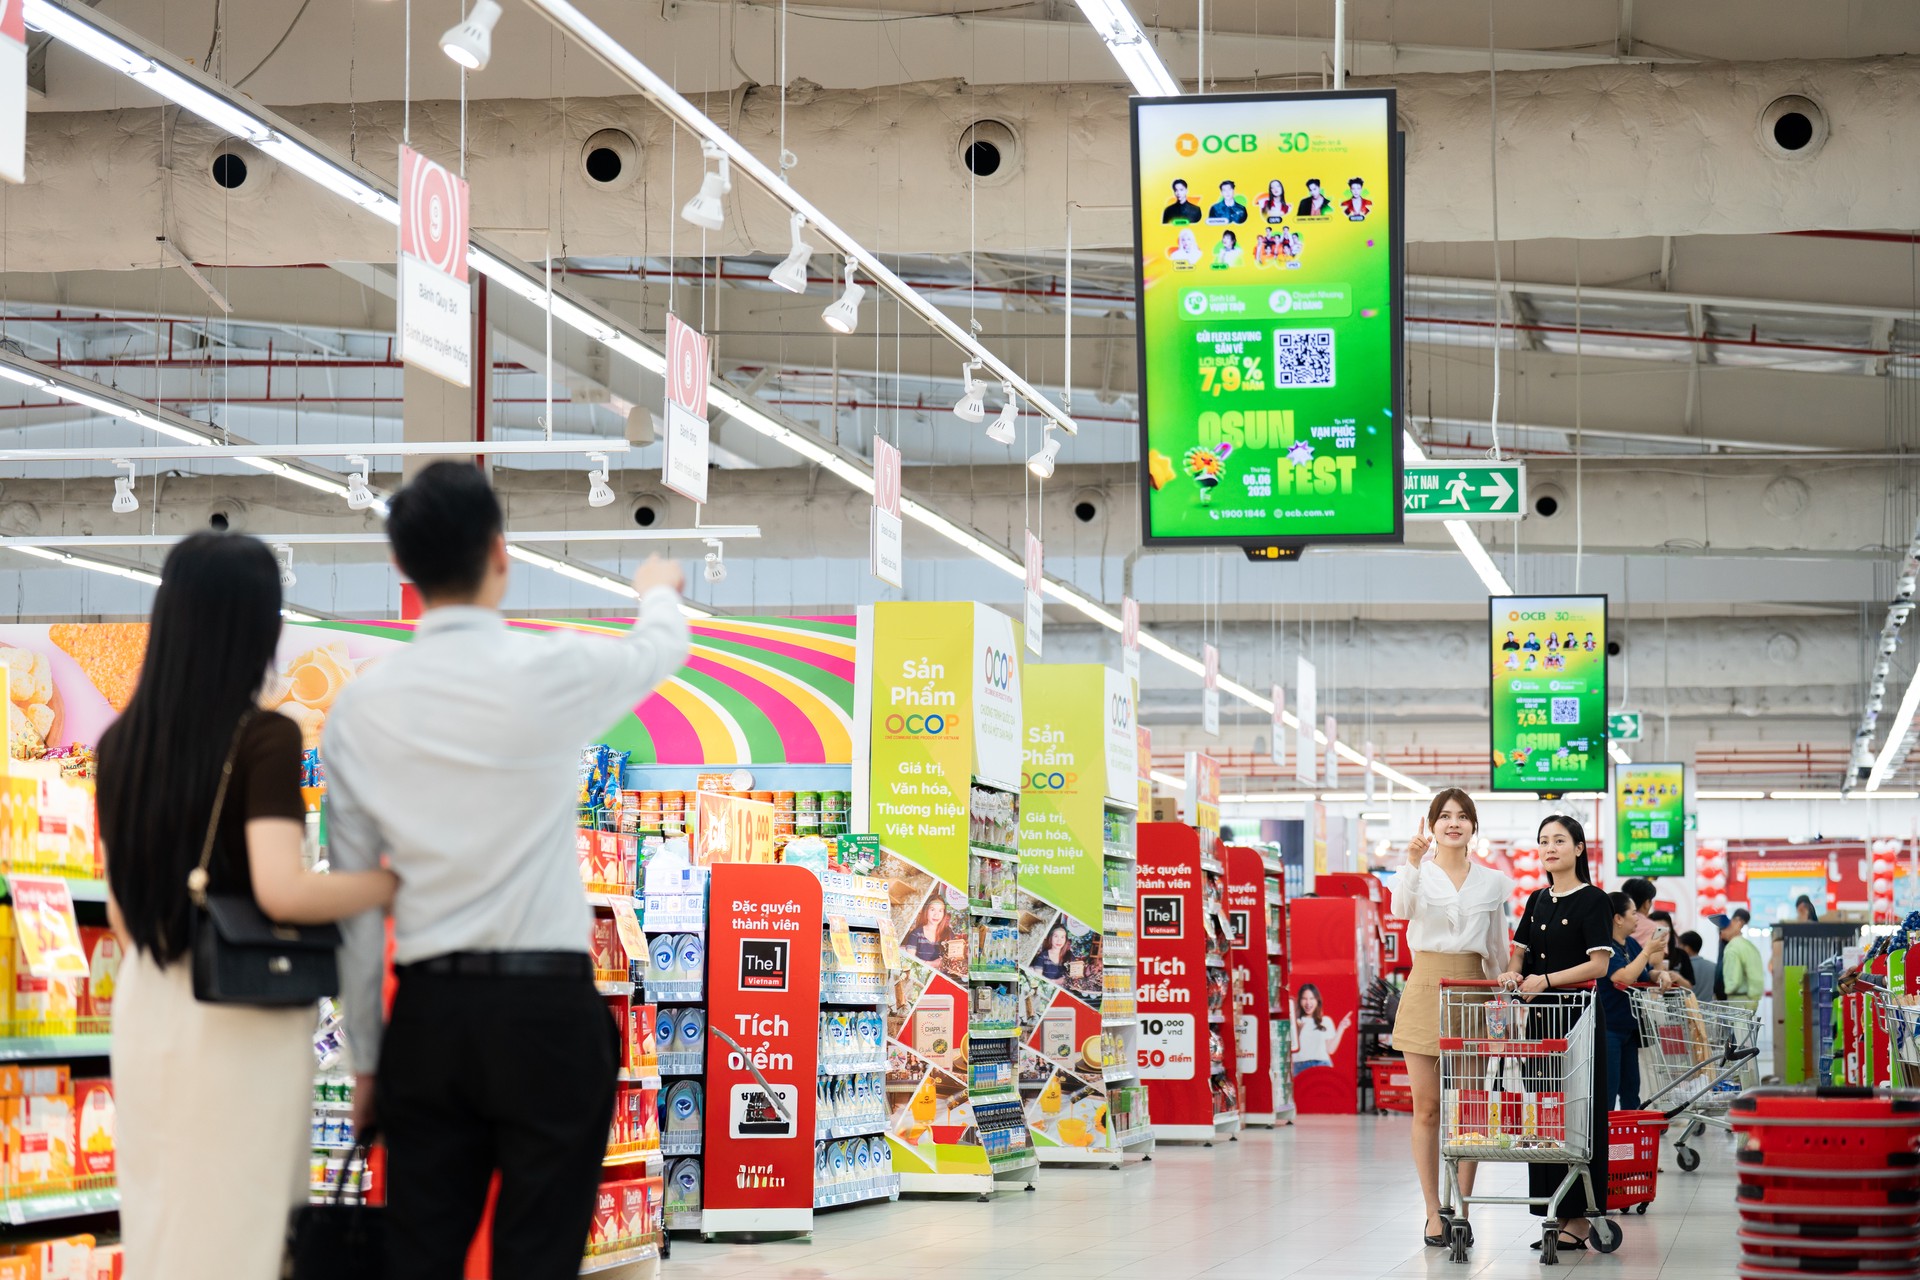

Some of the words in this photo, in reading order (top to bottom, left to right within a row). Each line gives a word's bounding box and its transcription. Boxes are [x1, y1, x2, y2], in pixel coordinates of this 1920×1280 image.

[1202, 133, 1258, 154] OCB
[1276, 131, 1310, 153] 30
[1231, 331, 1262, 342] SAVING
[1198, 365, 1241, 397] 7,9
[1197, 409, 1295, 450] OSUN
[1335, 437, 1356, 449] CITY
[1277, 455, 1357, 495] FEST
[1403, 472, 1418, 490] OÁT
[1403, 494, 1429, 509] XIT
[1221, 510, 1243, 519] 1900
[1243, 509, 1266, 518] 1846
[1284, 508, 1335, 518] ocb.com.vn
[1520, 611, 1546, 621] OCB
[902, 656, 945, 679] Sản
[985, 646, 1014, 692] OCOP
[891, 681, 955, 706] Phẩm
[885, 713, 960, 735] OCOP
[1028, 724, 1065, 744] Sản
[1516, 732, 1561, 751] OSUN
[1020, 743, 1075, 766] Phẩm
[1551, 753, 1589, 772] FEST
[898, 762, 922, 775] Giá
[925, 762, 945, 777] trị,
[891, 782, 917, 795] Văn
[921, 782, 951, 797] hóa,
[877, 802, 934, 818] Thương
[935, 802, 965, 818] hiệu
[1025, 812, 1047, 823] Giá
[1048, 812, 1066, 825] trị,
[885, 823, 914, 838] Việt
[918, 823, 955, 836] Nam!
[1020, 829, 1043, 840] Văn
[1045, 829, 1072, 842] hóa,
[1057, 846, 1083, 860] hiệu
[1043, 864, 1075, 875] Nam!
[1157, 863, 1191, 876] quyền
[1167, 878, 1191, 889] viên
[731, 900, 757, 914] Đặc
[760, 899, 801, 915] quyền
[732, 918, 768, 931] thành
[772, 918, 800, 931] viên
[1139, 957, 1186, 975] Tích
[748, 977, 780, 986] Vietnam
[1136, 979, 1190, 1003] điểm
[734, 1013, 789, 1036] Tích
[1140, 1019, 1163, 1035] 10
[1137, 1049, 1165, 1067] 50
